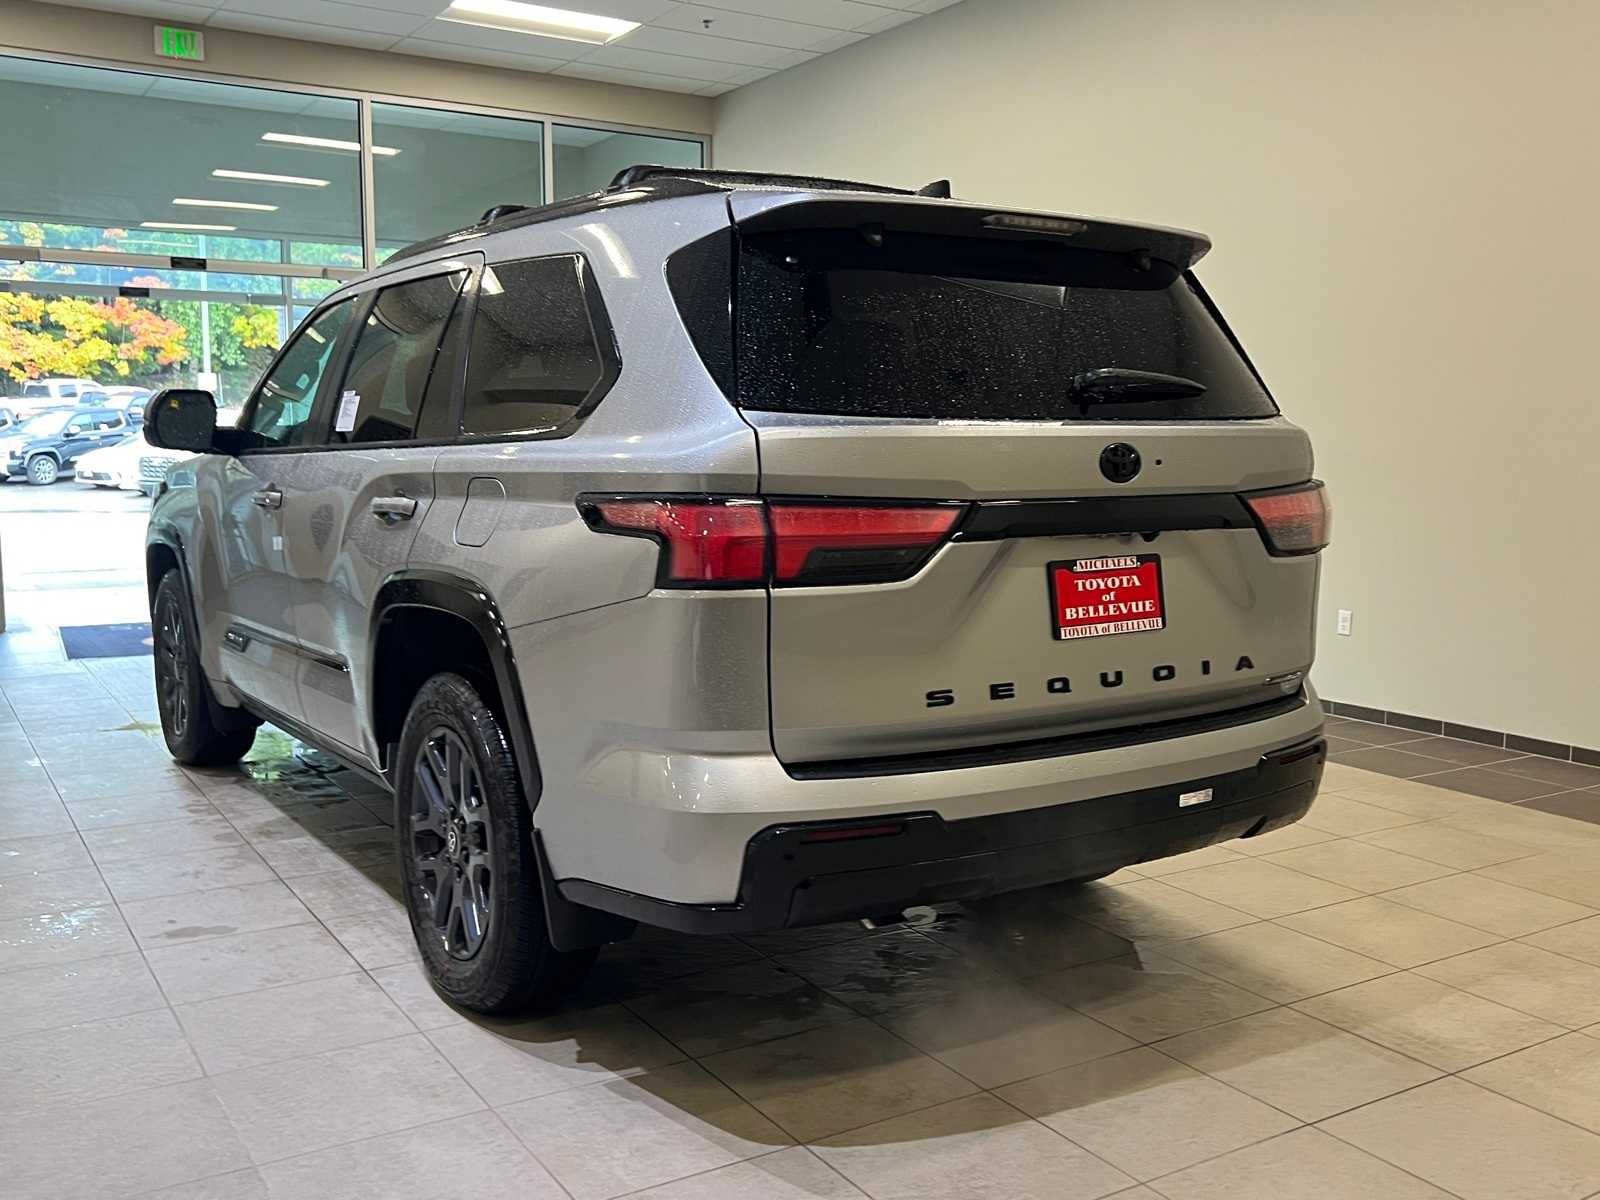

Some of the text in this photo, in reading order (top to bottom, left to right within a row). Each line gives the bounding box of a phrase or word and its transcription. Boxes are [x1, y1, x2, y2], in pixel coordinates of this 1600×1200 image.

[1079, 557, 1136, 570] MICHAELS
[1074, 575, 1141, 592] TOYOTA
[1101, 591, 1116, 602] of
[1065, 600, 1156, 620] BELLEVUE
[1062, 618, 1162, 638] TOYOTA of BELLEVUE
[925, 655, 1255, 708] SEQUOIA
